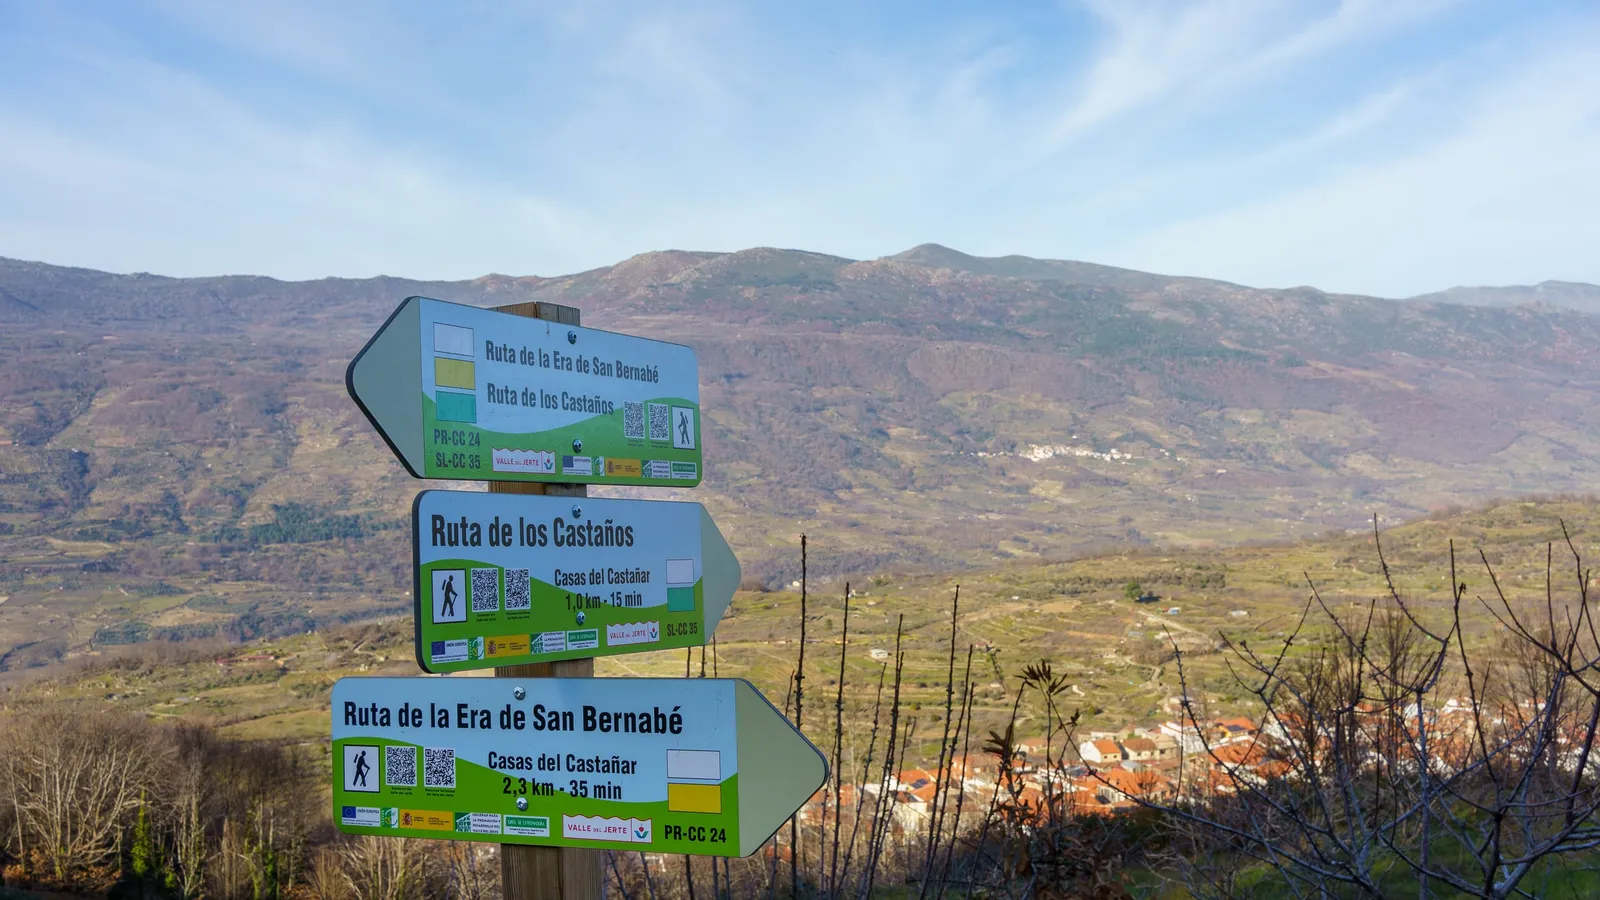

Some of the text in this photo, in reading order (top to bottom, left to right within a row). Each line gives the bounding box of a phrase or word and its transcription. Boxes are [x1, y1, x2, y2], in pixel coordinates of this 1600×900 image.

[486, 340, 659, 384] Ruta de la Era de San Bernabé
[487, 382, 614, 416] Ruta de los Castaños
[434, 429, 480, 448] PR-CC 24
[436, 452, 481, 469] SL-CC 35
[432, 514, 634, 547] Ruta de los Castaños
[554, 568, 650, 587] Casas del Castañar
[566, 593, 583, 613] 1,0
[585, 592, 601, 609] km
[610, 592, 622, 608] 15
[625, 592, 642, 607] min
[667, 622, 698, 637] SL-CC 35
[344, 701, 683, 734] Ruta de la Era de San Bernabé
[488, 751, 637, 774] Casas del Castañar
[503, 777, 527, 797] 2,3
[532, 778, 554, 796] km
[570, 780, 588, 798] 35
[594, 781, 622, 800] min
[665, 825, 726, 843] PR-CC 24
